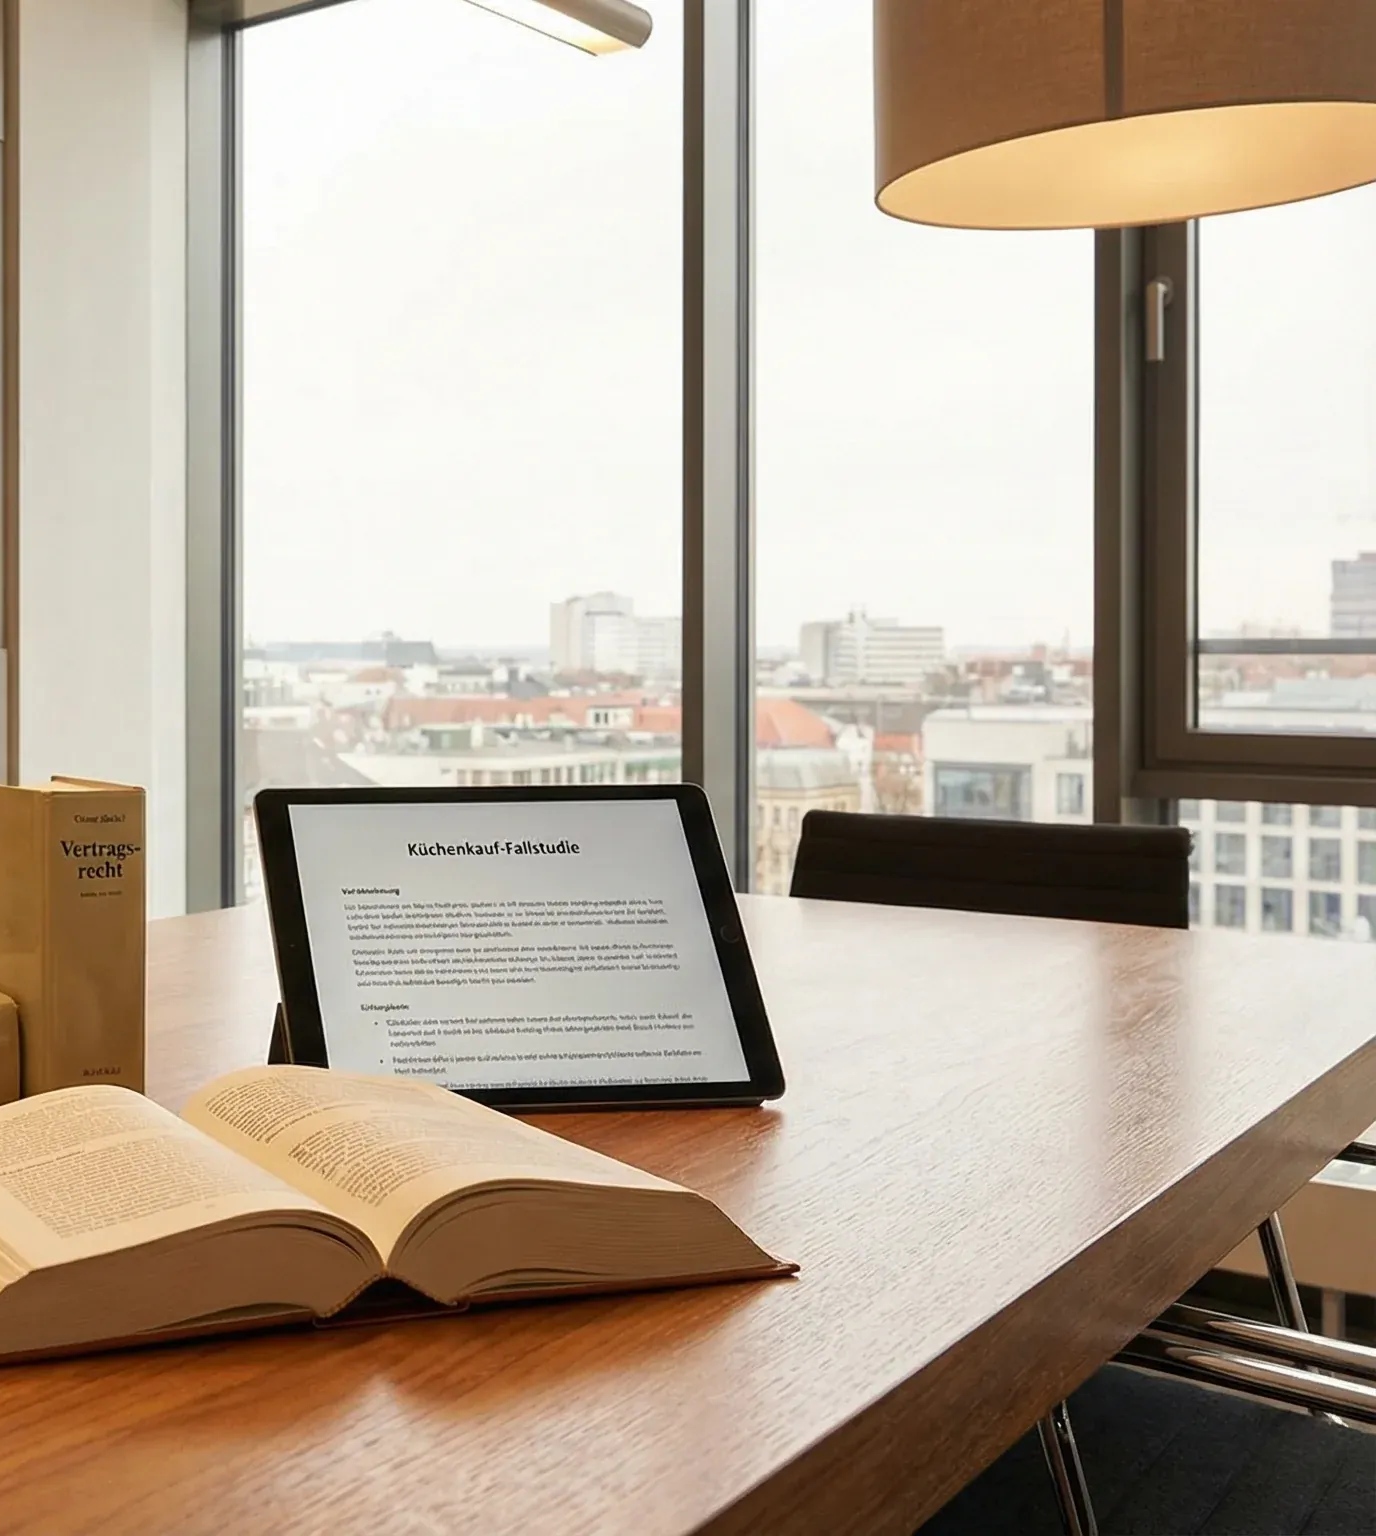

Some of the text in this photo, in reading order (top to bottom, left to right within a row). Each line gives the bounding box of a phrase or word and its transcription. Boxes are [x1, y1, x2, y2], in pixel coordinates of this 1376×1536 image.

[60, 840, 141, 861] Vertrags-
[407, 840, 581, 857] Küchenkauf-Fallstudie
[78, 861, 123, 879] recht
